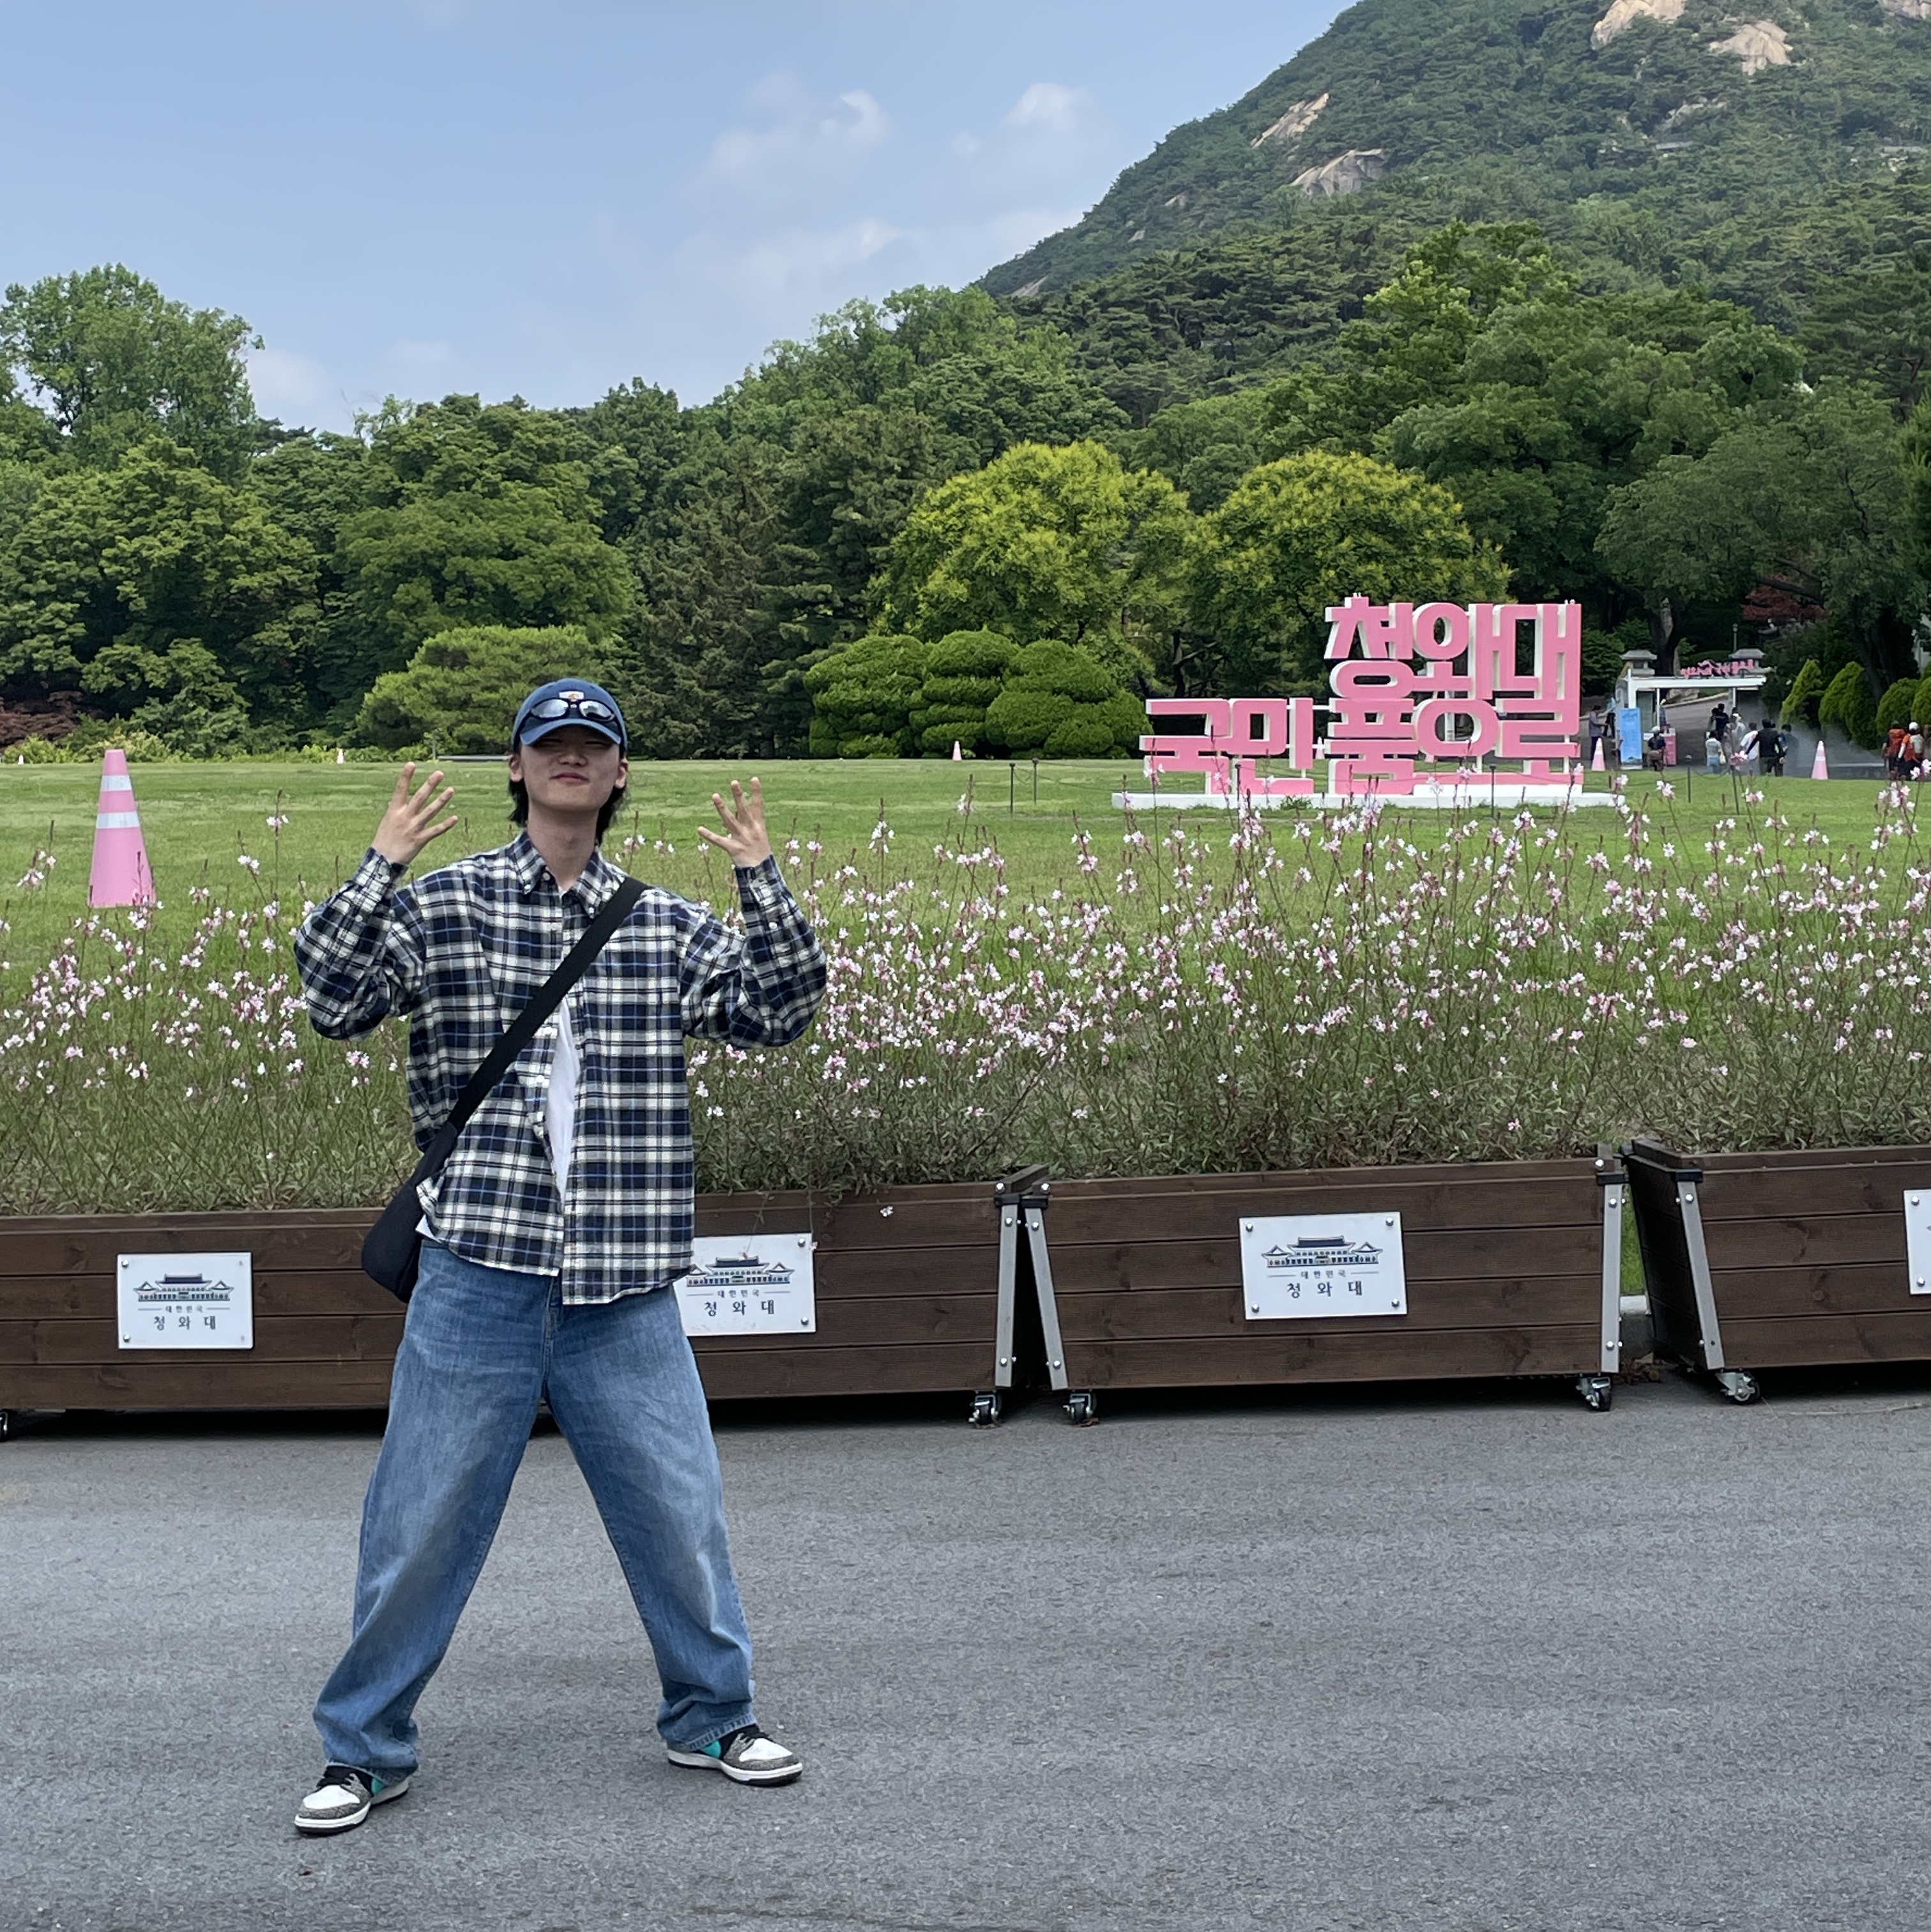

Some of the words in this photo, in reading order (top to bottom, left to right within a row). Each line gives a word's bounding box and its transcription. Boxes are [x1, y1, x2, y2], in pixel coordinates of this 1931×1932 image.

[1324, 597, 1582, 700] 청와대
[1286, 1281, 1362, 1298] 청와대
[704, 1299, 775, 1317] 청와대
[153, 1316, 216, 1331] 청와대
